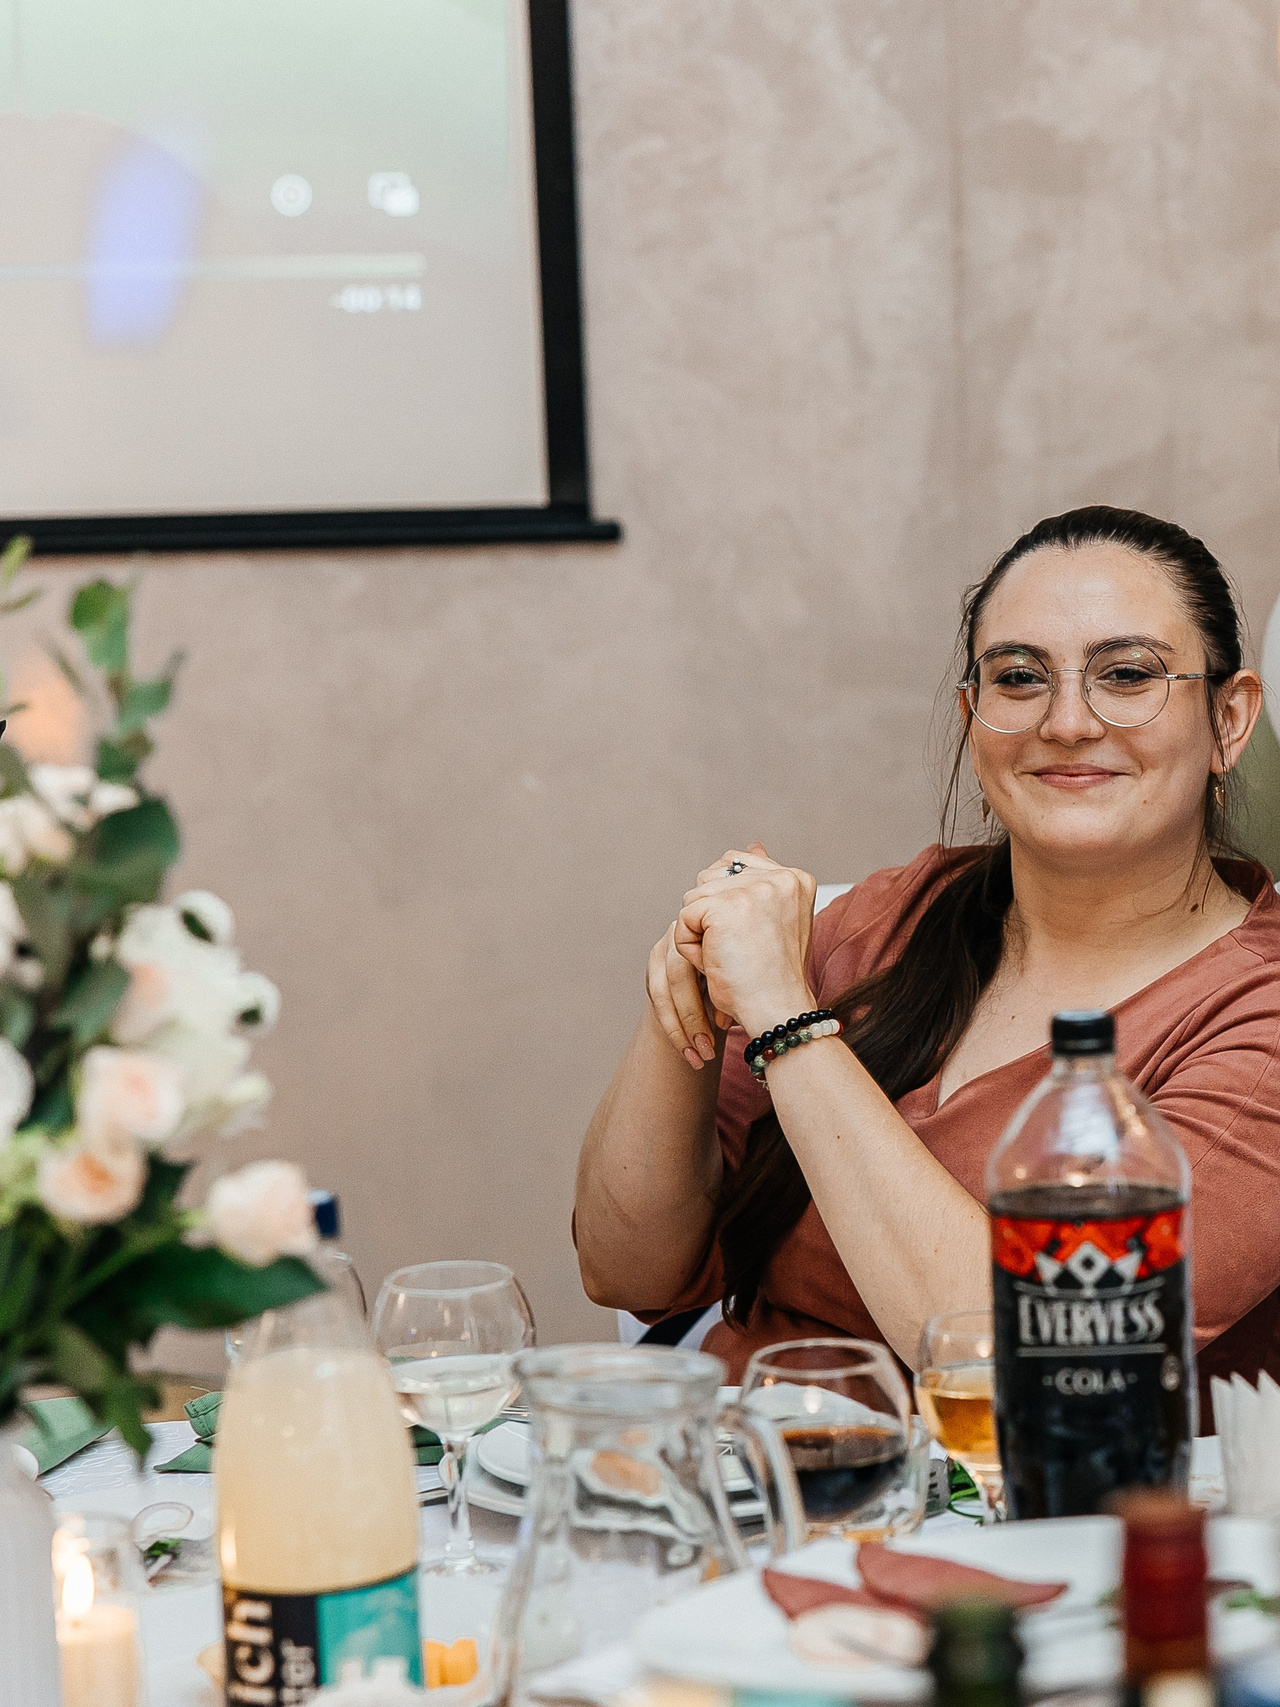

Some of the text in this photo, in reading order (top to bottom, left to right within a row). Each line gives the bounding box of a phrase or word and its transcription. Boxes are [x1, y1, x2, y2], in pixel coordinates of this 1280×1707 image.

[1018, 1290, 1166, 1346] EVERVESS
[1055, 1366, 1127, 1395] COLA
[226, 1600, 276, 1706] ich
